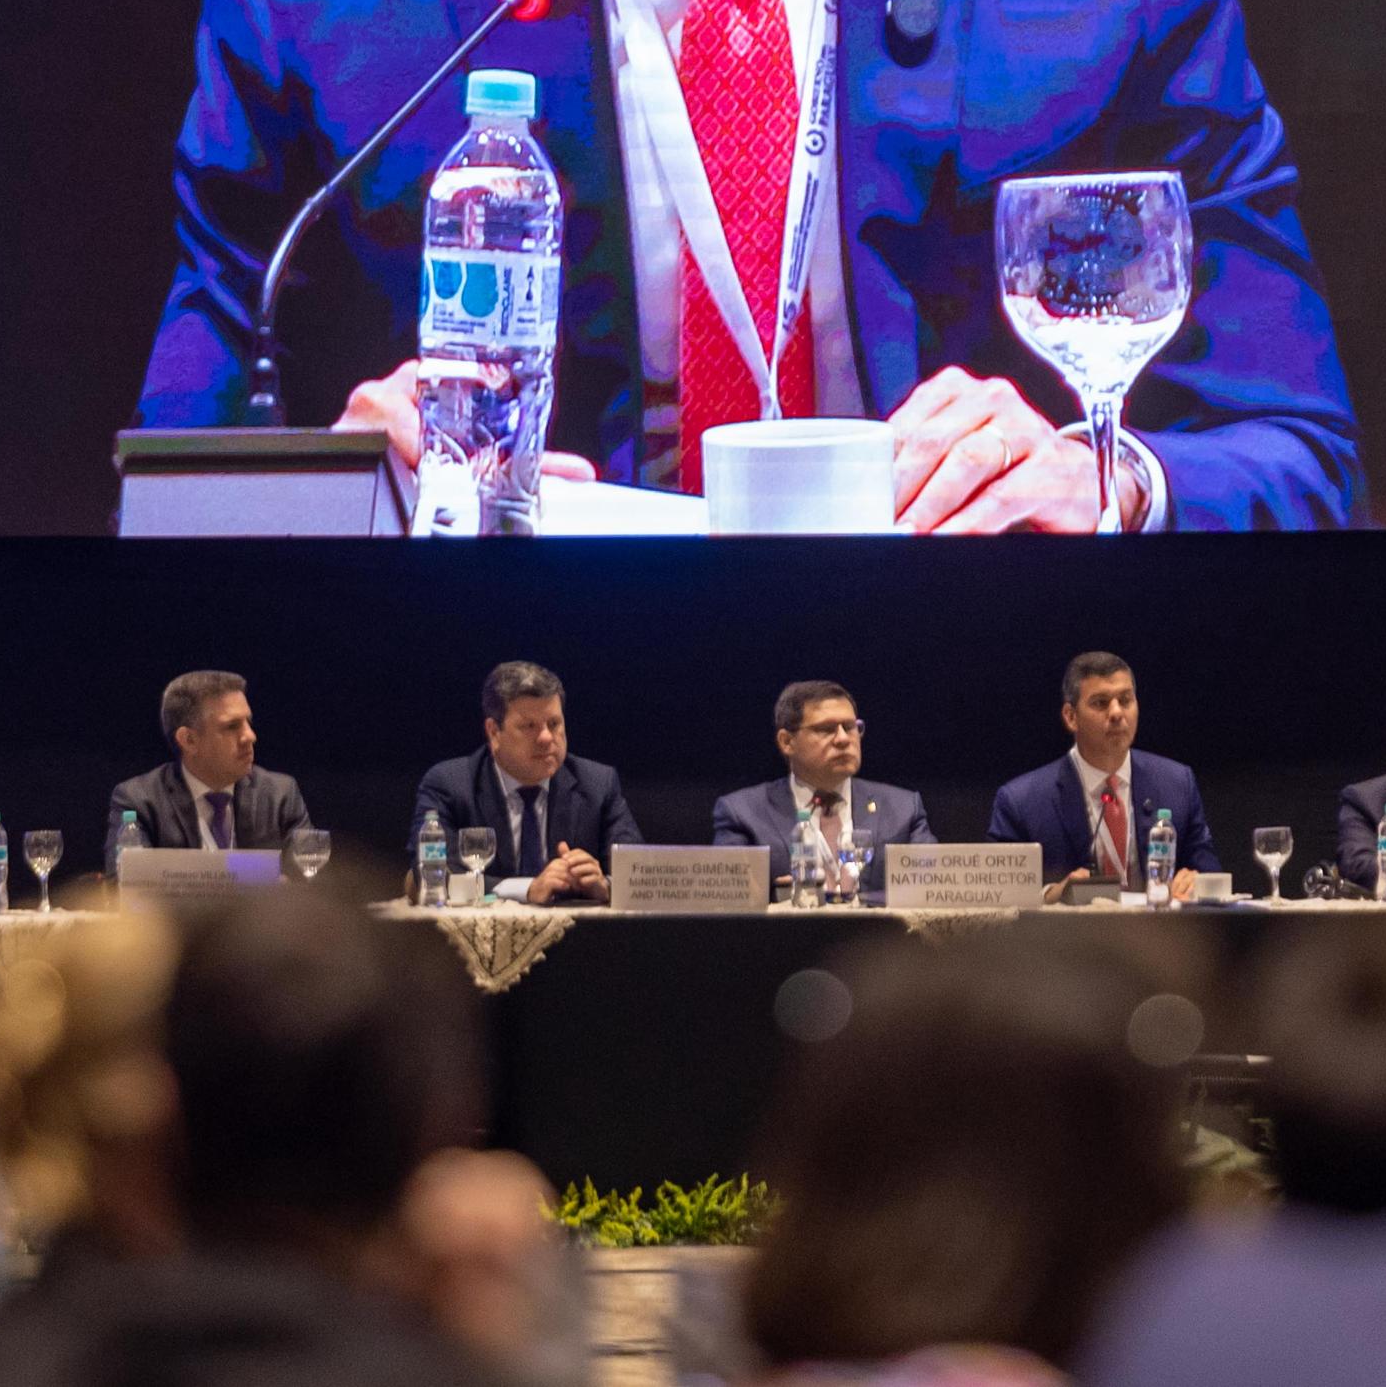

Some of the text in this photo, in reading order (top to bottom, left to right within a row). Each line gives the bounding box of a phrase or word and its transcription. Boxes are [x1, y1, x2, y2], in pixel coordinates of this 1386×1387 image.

[901, 854, 1027, 868] Oscar ORUÉ ORTIZ
[633, 862, 750, 874] Francisco GIMÉNEZ
[630, 877, 750, 887] MINISTER OF INDUSTRY
[892, 873, 1036, 885] NATIONAL DIRECTOR
[631, 890, 750, 900] AND TRADE PARAGUAY
[926, 891, 1002, 903] PARAGUAY
